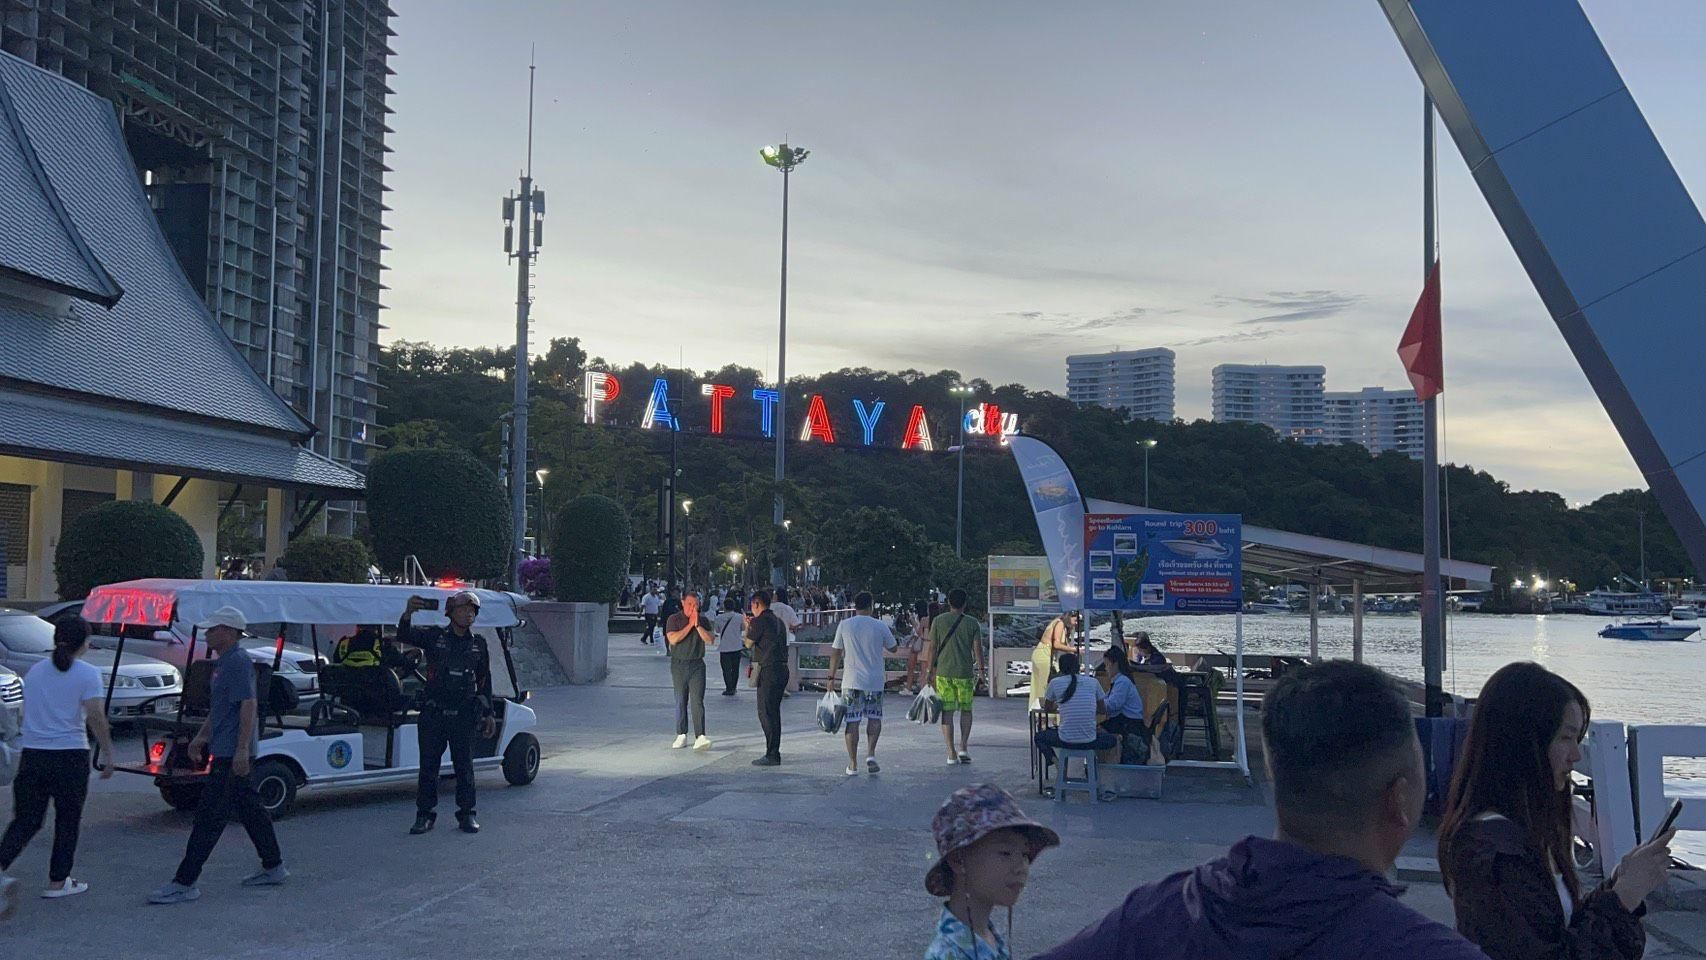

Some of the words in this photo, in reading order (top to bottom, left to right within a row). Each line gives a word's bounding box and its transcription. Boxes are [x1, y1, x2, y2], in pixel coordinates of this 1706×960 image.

[584, 371, 933, 451] PATTAYA
[963, 402, 1019, 446] city
[1169, 520, 1183, 529] trip
[1183, 519, 1217, 535] 300
